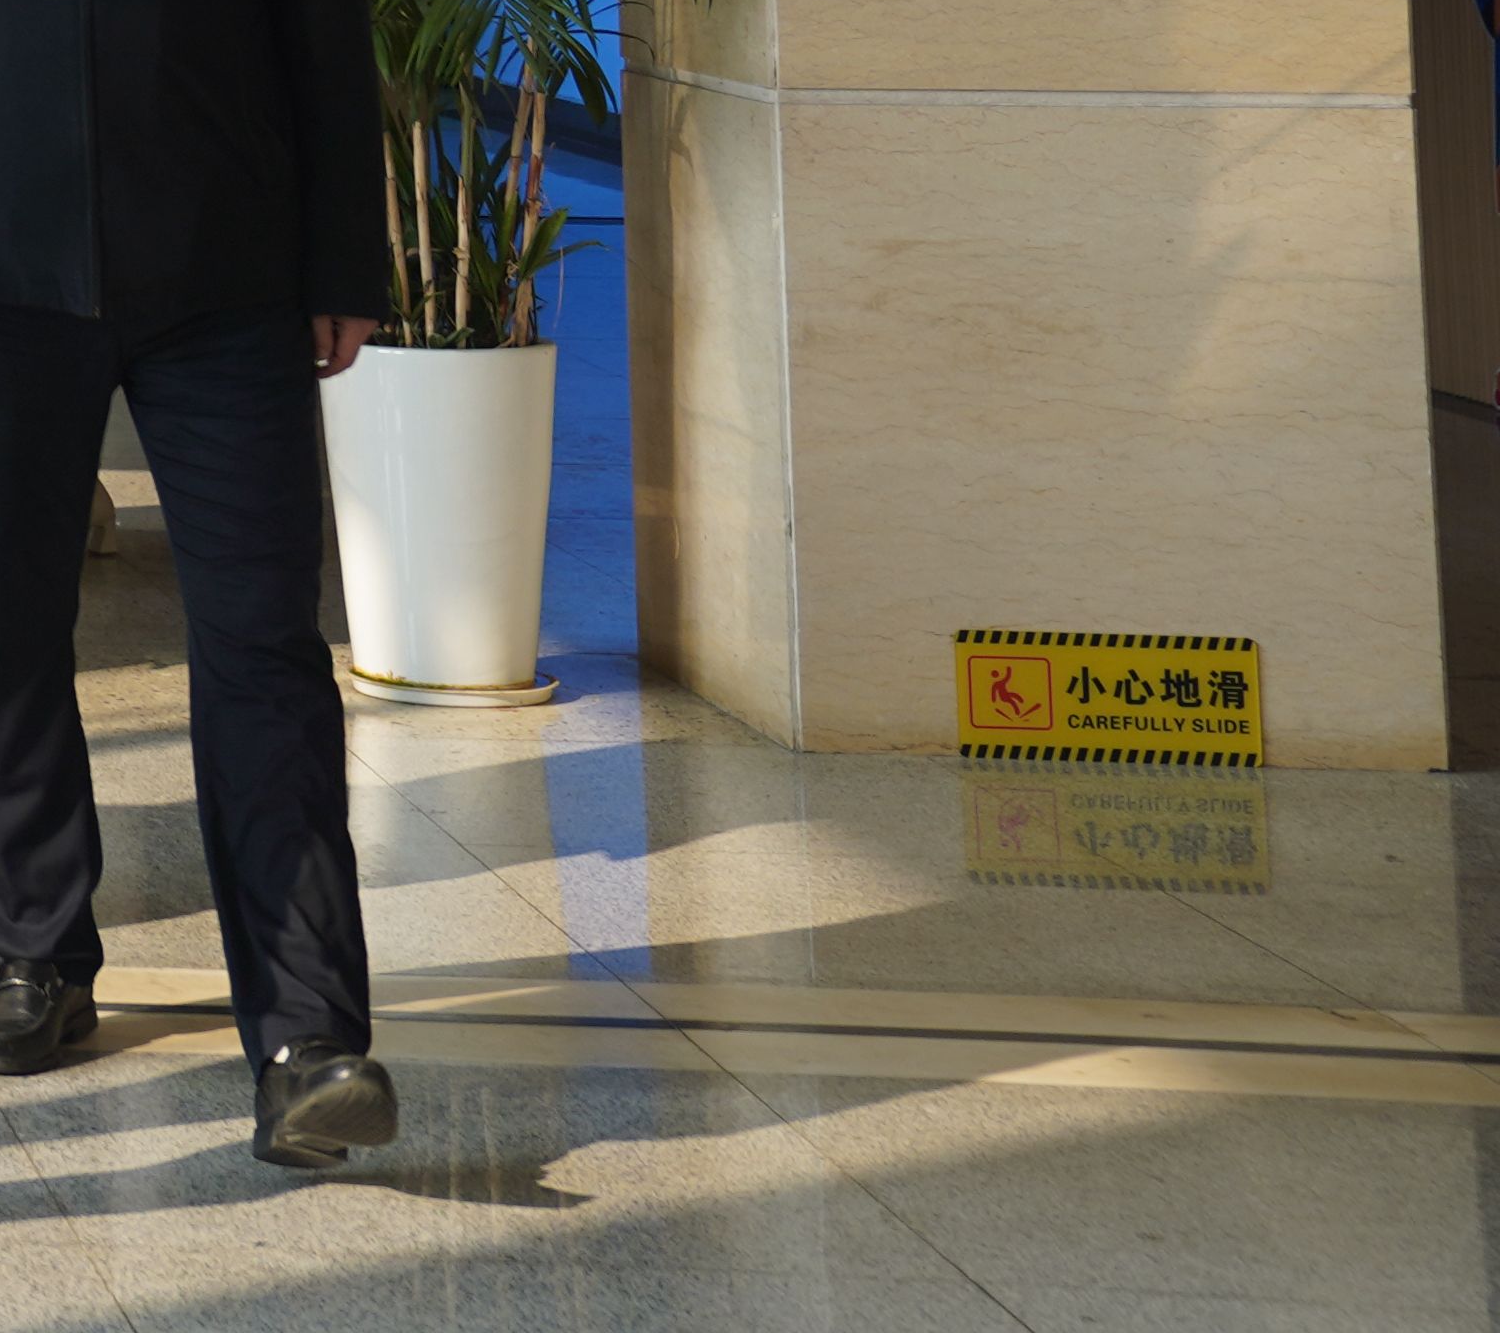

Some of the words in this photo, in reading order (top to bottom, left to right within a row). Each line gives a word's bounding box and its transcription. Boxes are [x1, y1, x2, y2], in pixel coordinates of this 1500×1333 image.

[1066, 666, 1249, 710] 小心地滑
[1067, 713, 1186, 734] CAREFULLY
[1192, 716, 1251, 735] SLIDE
